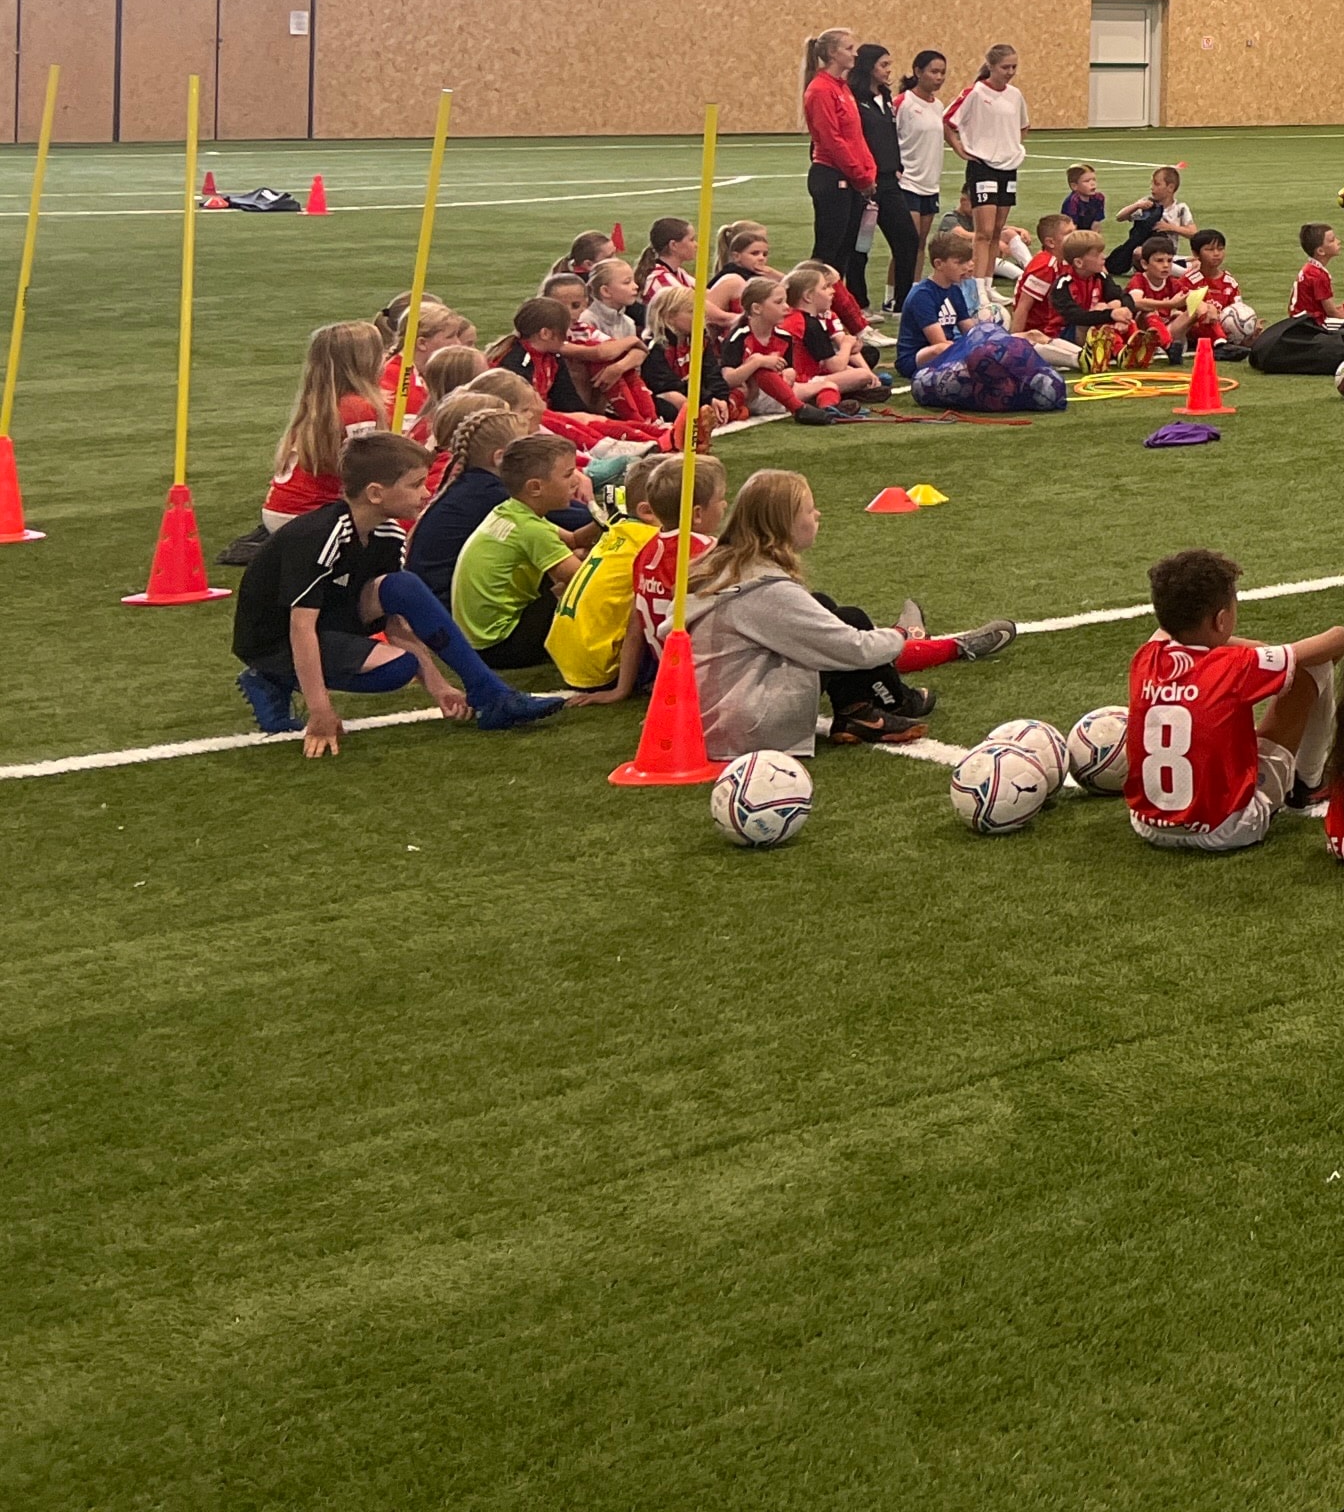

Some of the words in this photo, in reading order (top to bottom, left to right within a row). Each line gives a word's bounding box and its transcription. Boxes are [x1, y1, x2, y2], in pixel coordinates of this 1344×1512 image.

[977, 193, 988, 203] 19
[1141, 678, 1199, 705] Hydro
[1142, 705, 1194, 811] 8
